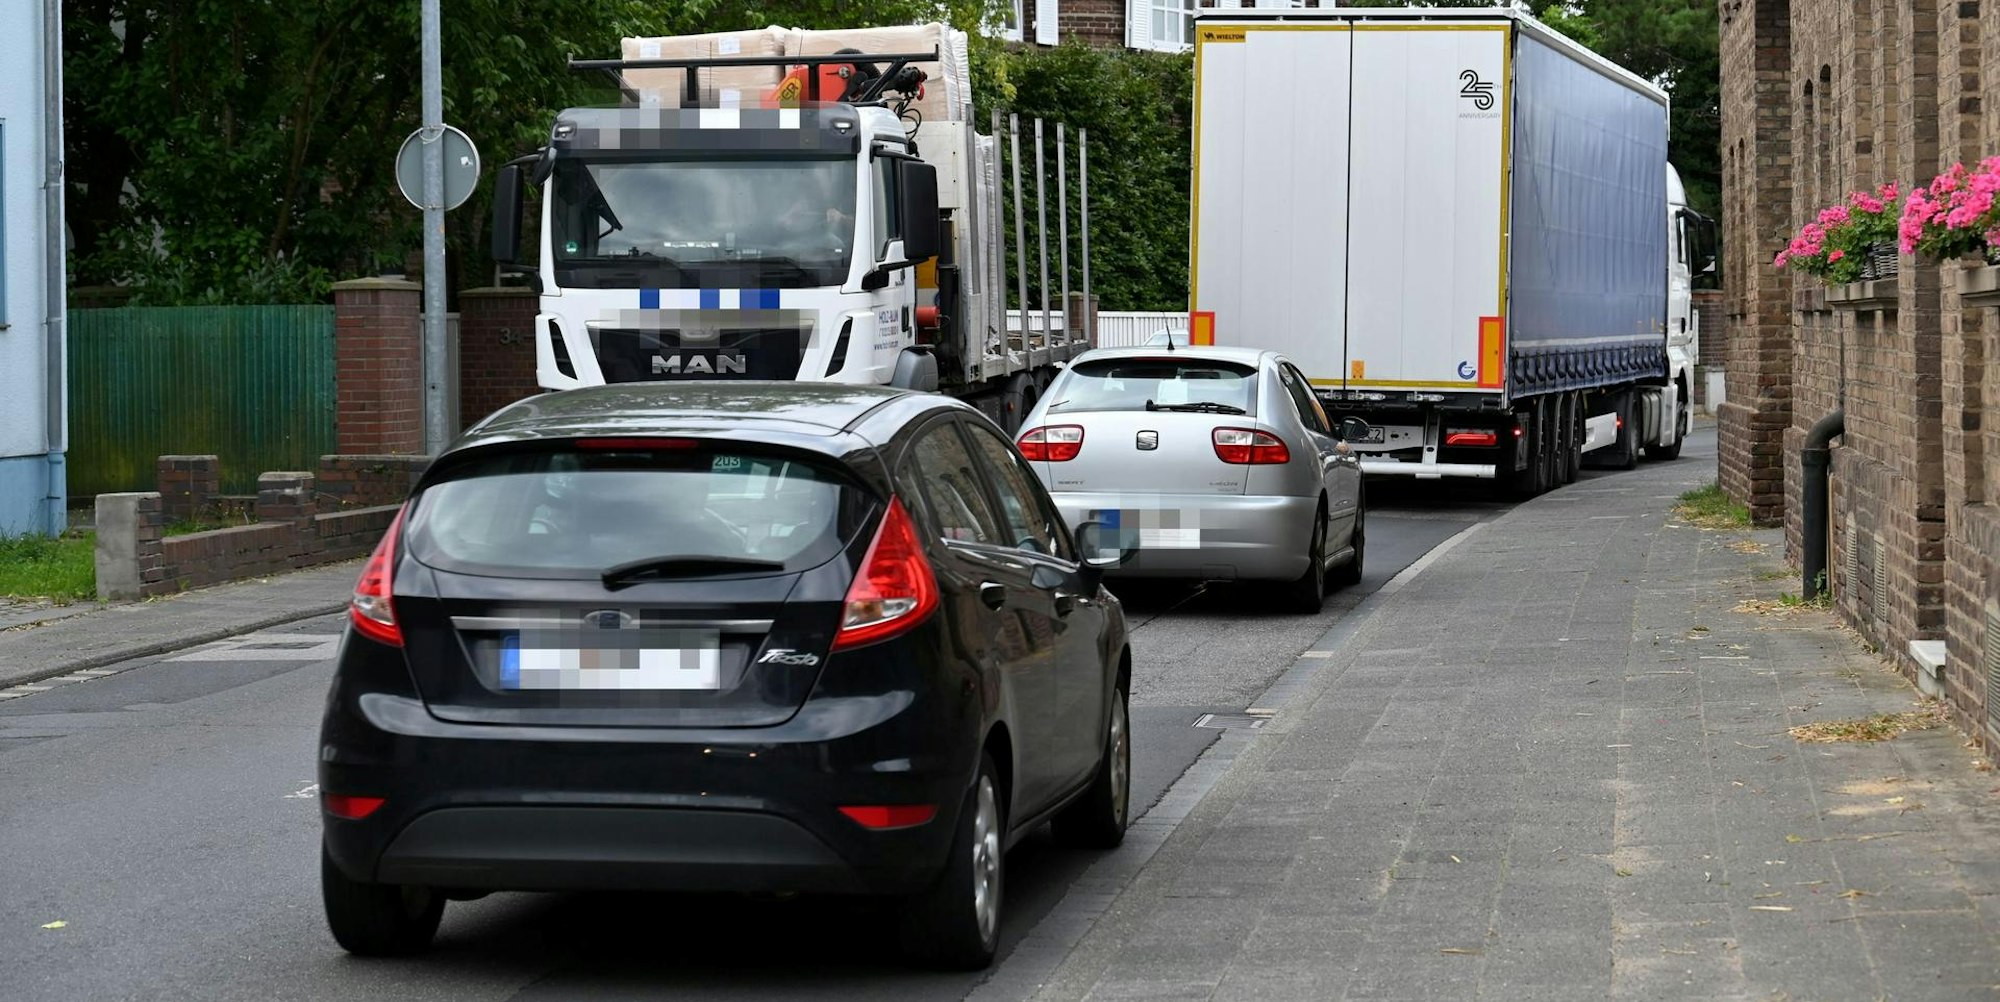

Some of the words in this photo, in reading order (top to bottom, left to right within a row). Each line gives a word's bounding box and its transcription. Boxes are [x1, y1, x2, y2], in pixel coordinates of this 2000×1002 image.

[1459, 69, 1494, 111] 25
[651, 354, 746, 374] MAN
[757, 648, 819, 666] Fiesta
